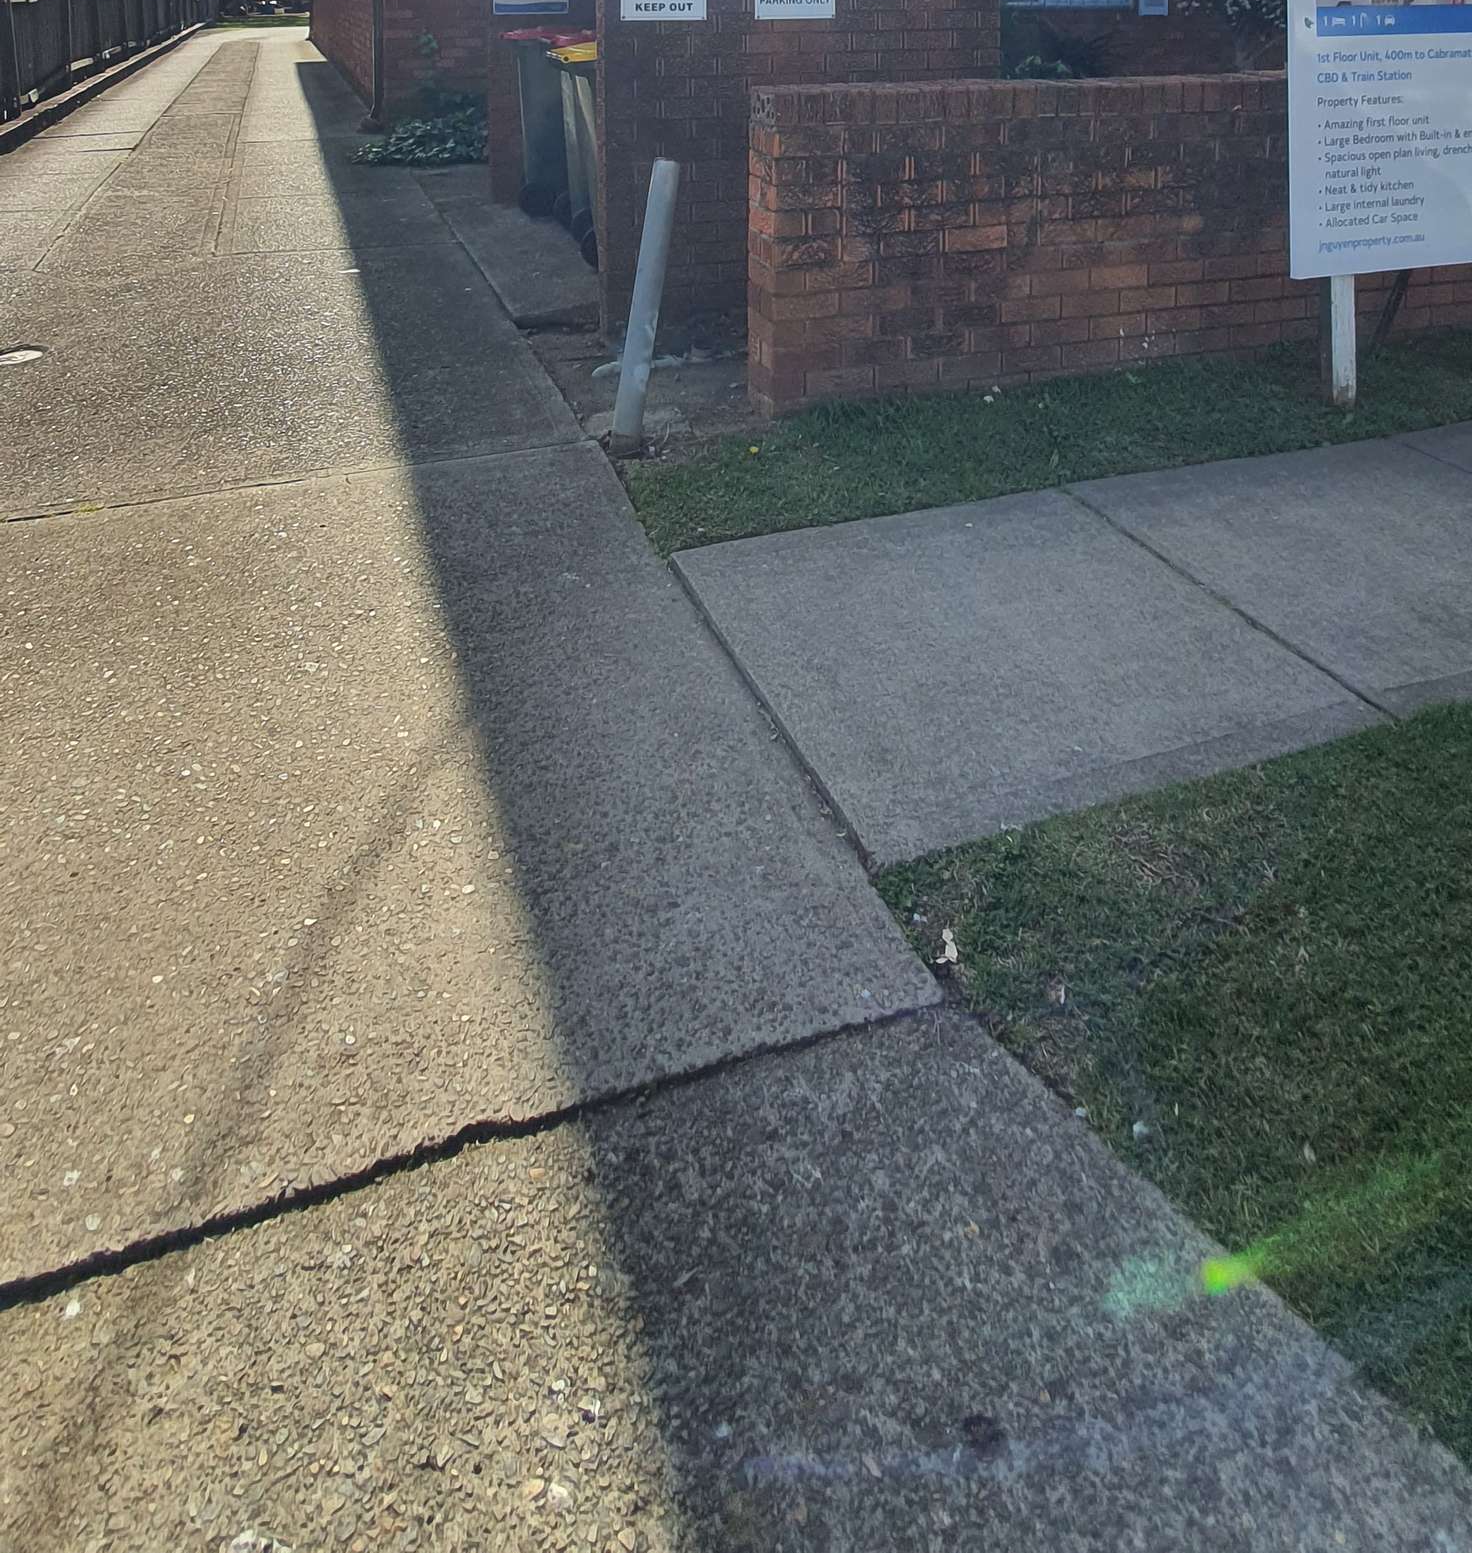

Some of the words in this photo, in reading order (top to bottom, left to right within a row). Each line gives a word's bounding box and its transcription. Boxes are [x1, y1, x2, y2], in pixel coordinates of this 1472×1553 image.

[635, 3, 666, 12] KEEP
[668, 3, 694, 12] OUT
[1317, 52, 1331, 64] 1st
[1333, 51, 1358, 63] Floor
[1384, 49, 1413, 61] 400m
[1414, 50, 1426, 60] to
[1317, 72, 1339, 84] CBD
[1341, 71, 1348, 83] &
[1351, 71, 1376, 83] Train
[1377, 69, 1412, 82] Station
[1317, 96, 1359, 109] Property
[1324, 119, 1364, 132] Amazing
[1366, 116, 1387, 128] first
[1388, 114, 1410, 127] floor
[1411, 115, 1430, 126] unit
[1324, 135, 1350, 149] Large
[1352, 133, 1395, 145] Bedroom
[1396, 131, 1418, 143] with
[1324, 151, 1367, 166] Spacious
[1368, 150, 1392, 163] open
[1393, 147, 1413, 161] plan
[1325, 167, 1359, 179] natural
[1360, 165, 1382, 180] light
[1325, 184, 1348, 195] Neat
[1350, 183, 1357, 194] &
[1359, 180, 1378, 194] tidy
[1379, 179, 1414, 192] kitchen
[1325, 202, 1352, 215] Large
[1353, 197, 1389, 210] internal
[1391, 194, 1425, 208] laundry
[1325, 214, 1370, 228] Allocated
[1371, 213, 1388, 224] Car
[1390, 211, 1419, 225] Space
